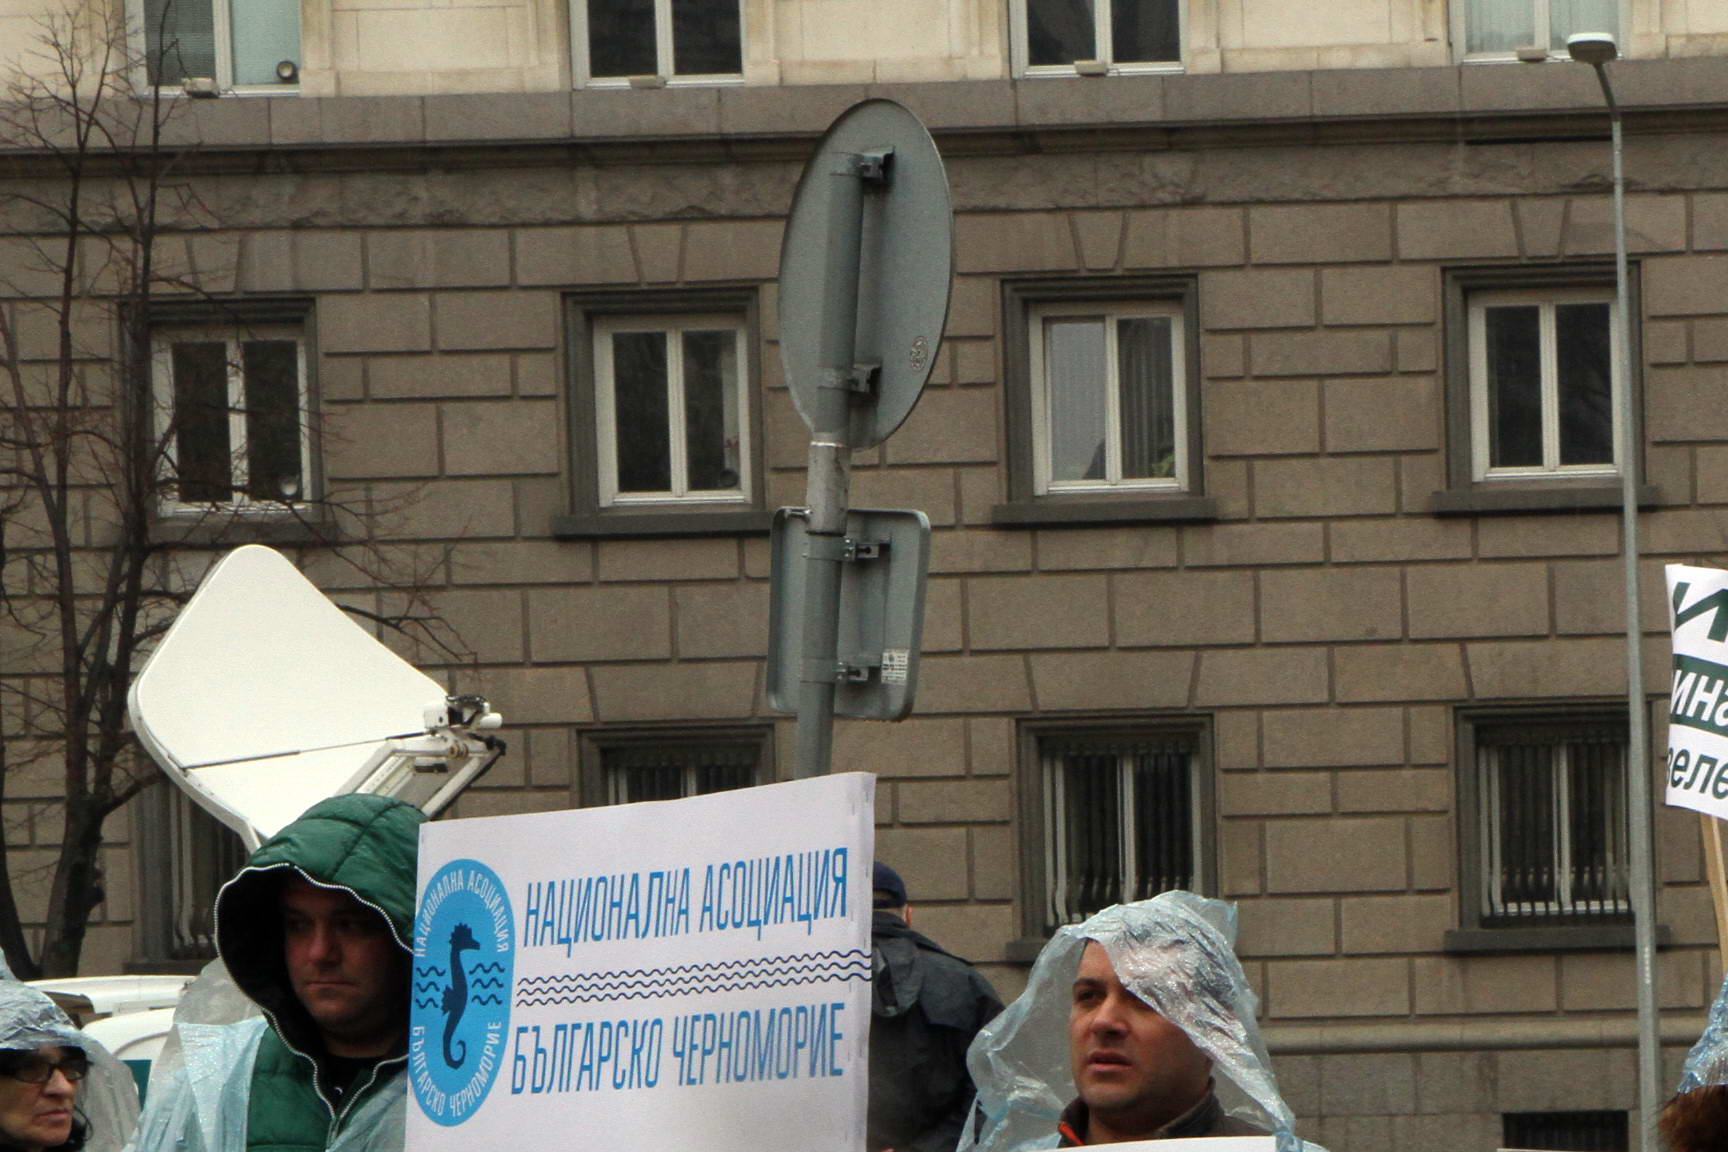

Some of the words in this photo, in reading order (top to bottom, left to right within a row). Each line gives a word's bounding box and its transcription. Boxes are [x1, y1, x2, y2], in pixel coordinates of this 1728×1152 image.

[414, 869, 465, 957] НАЦИОНАЛНА
[467, 869, 509, 953] АСОЦИАЦИЯ
[524, 868, 690, 958] НАЦИОНАЛНА
[700, 848, 848, 940] АСОЦИАЦИЯ
[411, 1025, 446, 1117] БЪЛГАРСКО
[450, 1021, 502, 1117] ЧЕРНОМОРИЕ
[511, 1018, 663, 1095] БЪЛГАРСКО
[673, 1003, 846, 1086] ЧЕРНОМОРИЕ
